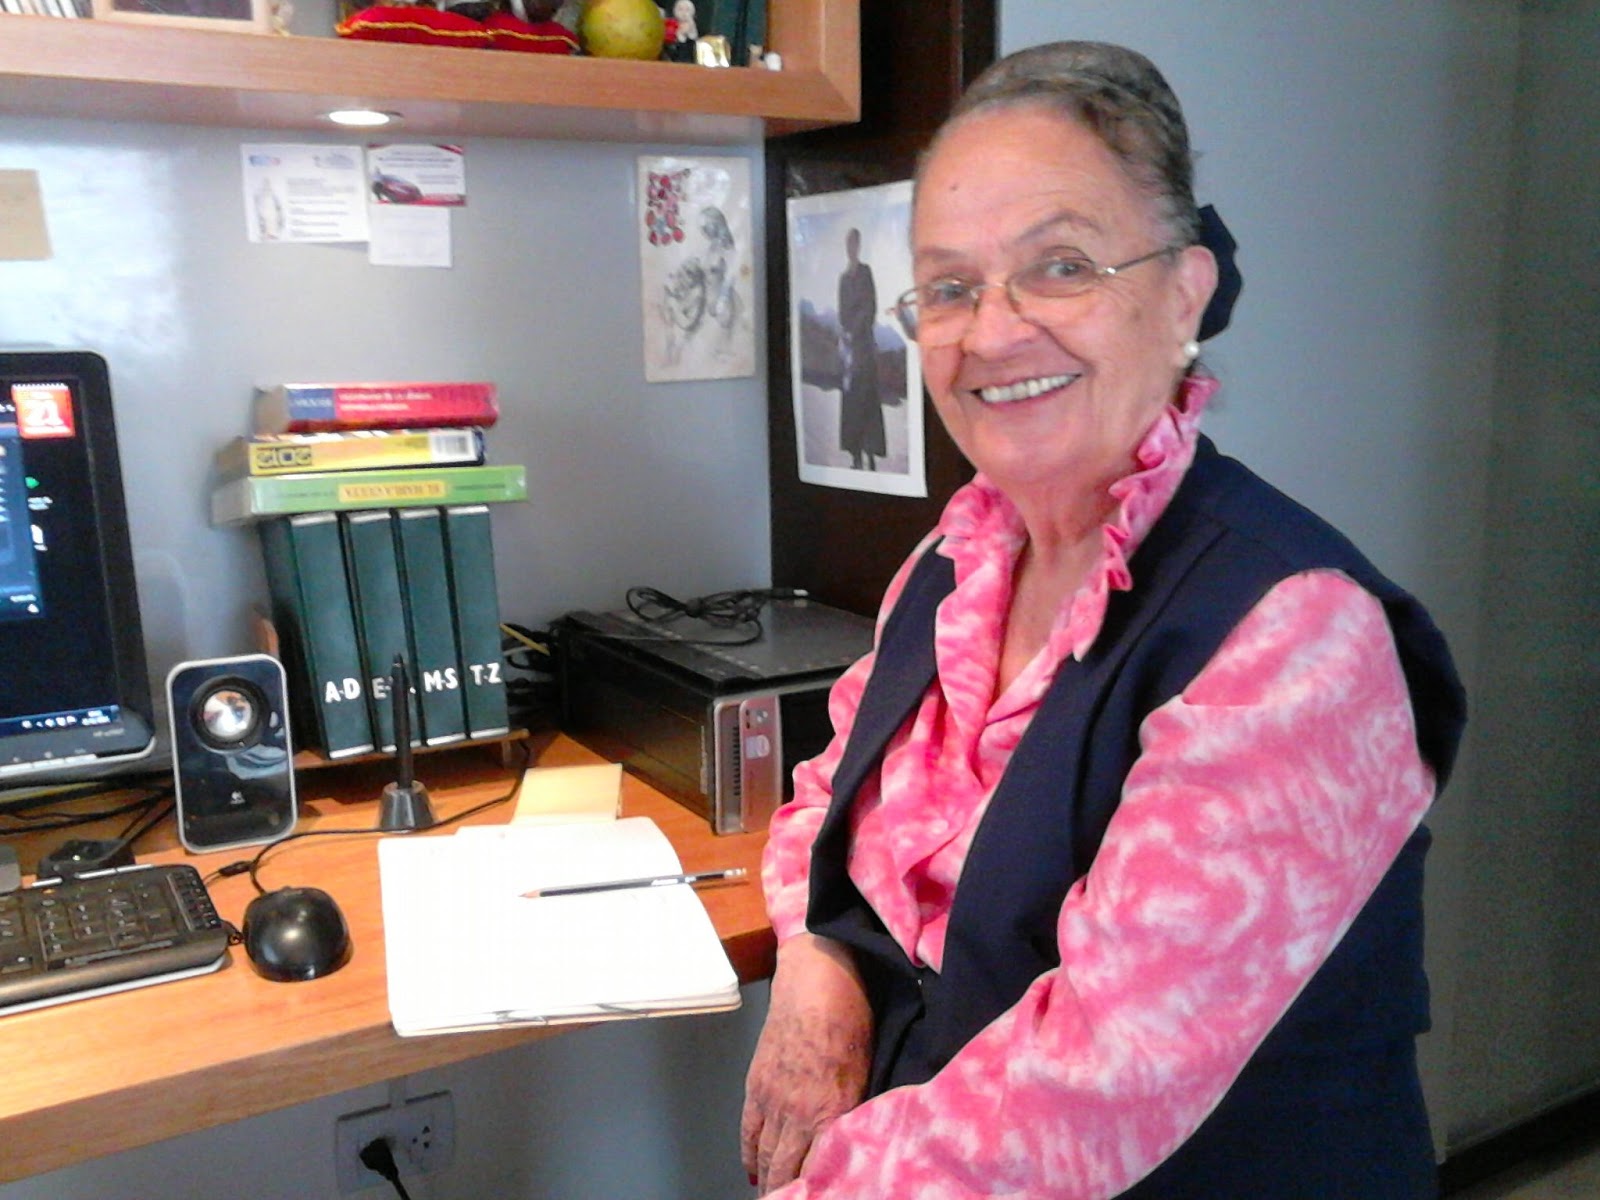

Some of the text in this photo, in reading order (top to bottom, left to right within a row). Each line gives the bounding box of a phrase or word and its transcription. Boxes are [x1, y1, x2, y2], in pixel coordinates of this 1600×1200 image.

[423, 668, 458, 692] M-S
[469, 662, 502, 686] T-Z
[325, 678, 361, 703] A-D
